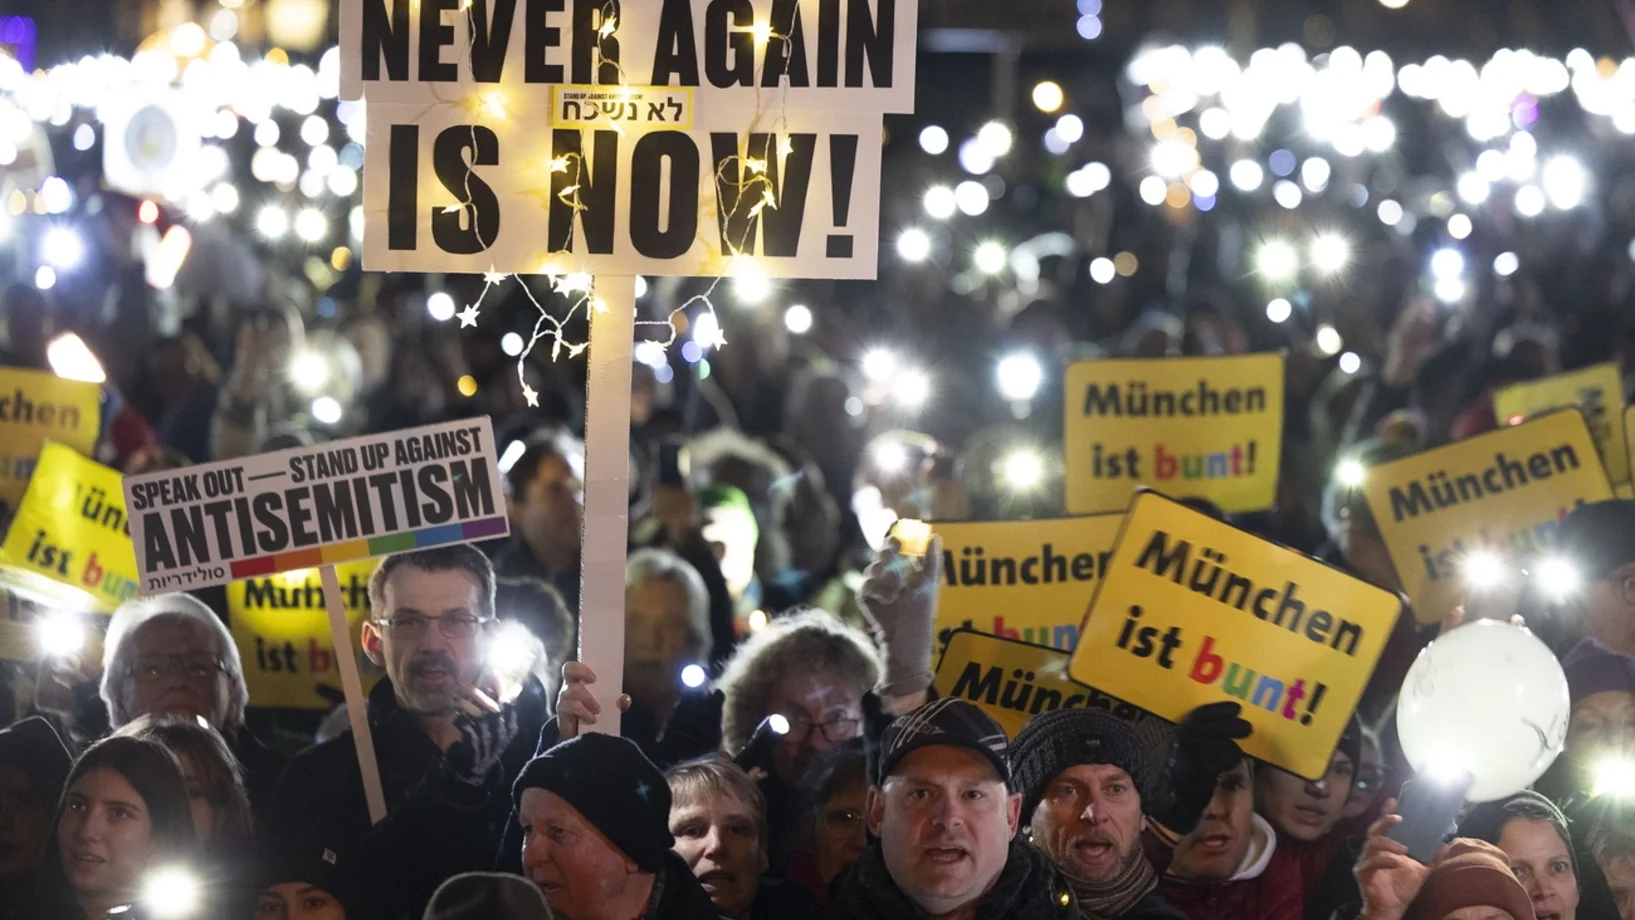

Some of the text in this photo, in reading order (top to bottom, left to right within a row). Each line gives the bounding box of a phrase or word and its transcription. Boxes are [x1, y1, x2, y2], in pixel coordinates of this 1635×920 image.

[361, 0, 894, 90] NEVER AGAIN
[562, 96, 683, 122] לא נשכח
[387, 124, 860, 260] IS NOW!
[1084, 379, 1267, 418] München
[131, 475, 202, 511] SPEAK
[203, 466, 245, 498] OUT
[289, 447, 359, 484] STAND
[360, 441, 390, 472] UP
[395, 426, 482, 467] AGAINST
[1091, 438, 1258, 481] ist bunt!
[1388, 442, 1582, 523] München
[27, 529, 74, 577] ist
[143, 456, 496, 573] ANTISEMITISM
[148, 566, 225, 590] סולידריות
[1134, 529, 1364, 658] München
[1114, 604, 1184, 669] ist
[1187, 634, 1328, 726] bunt!
